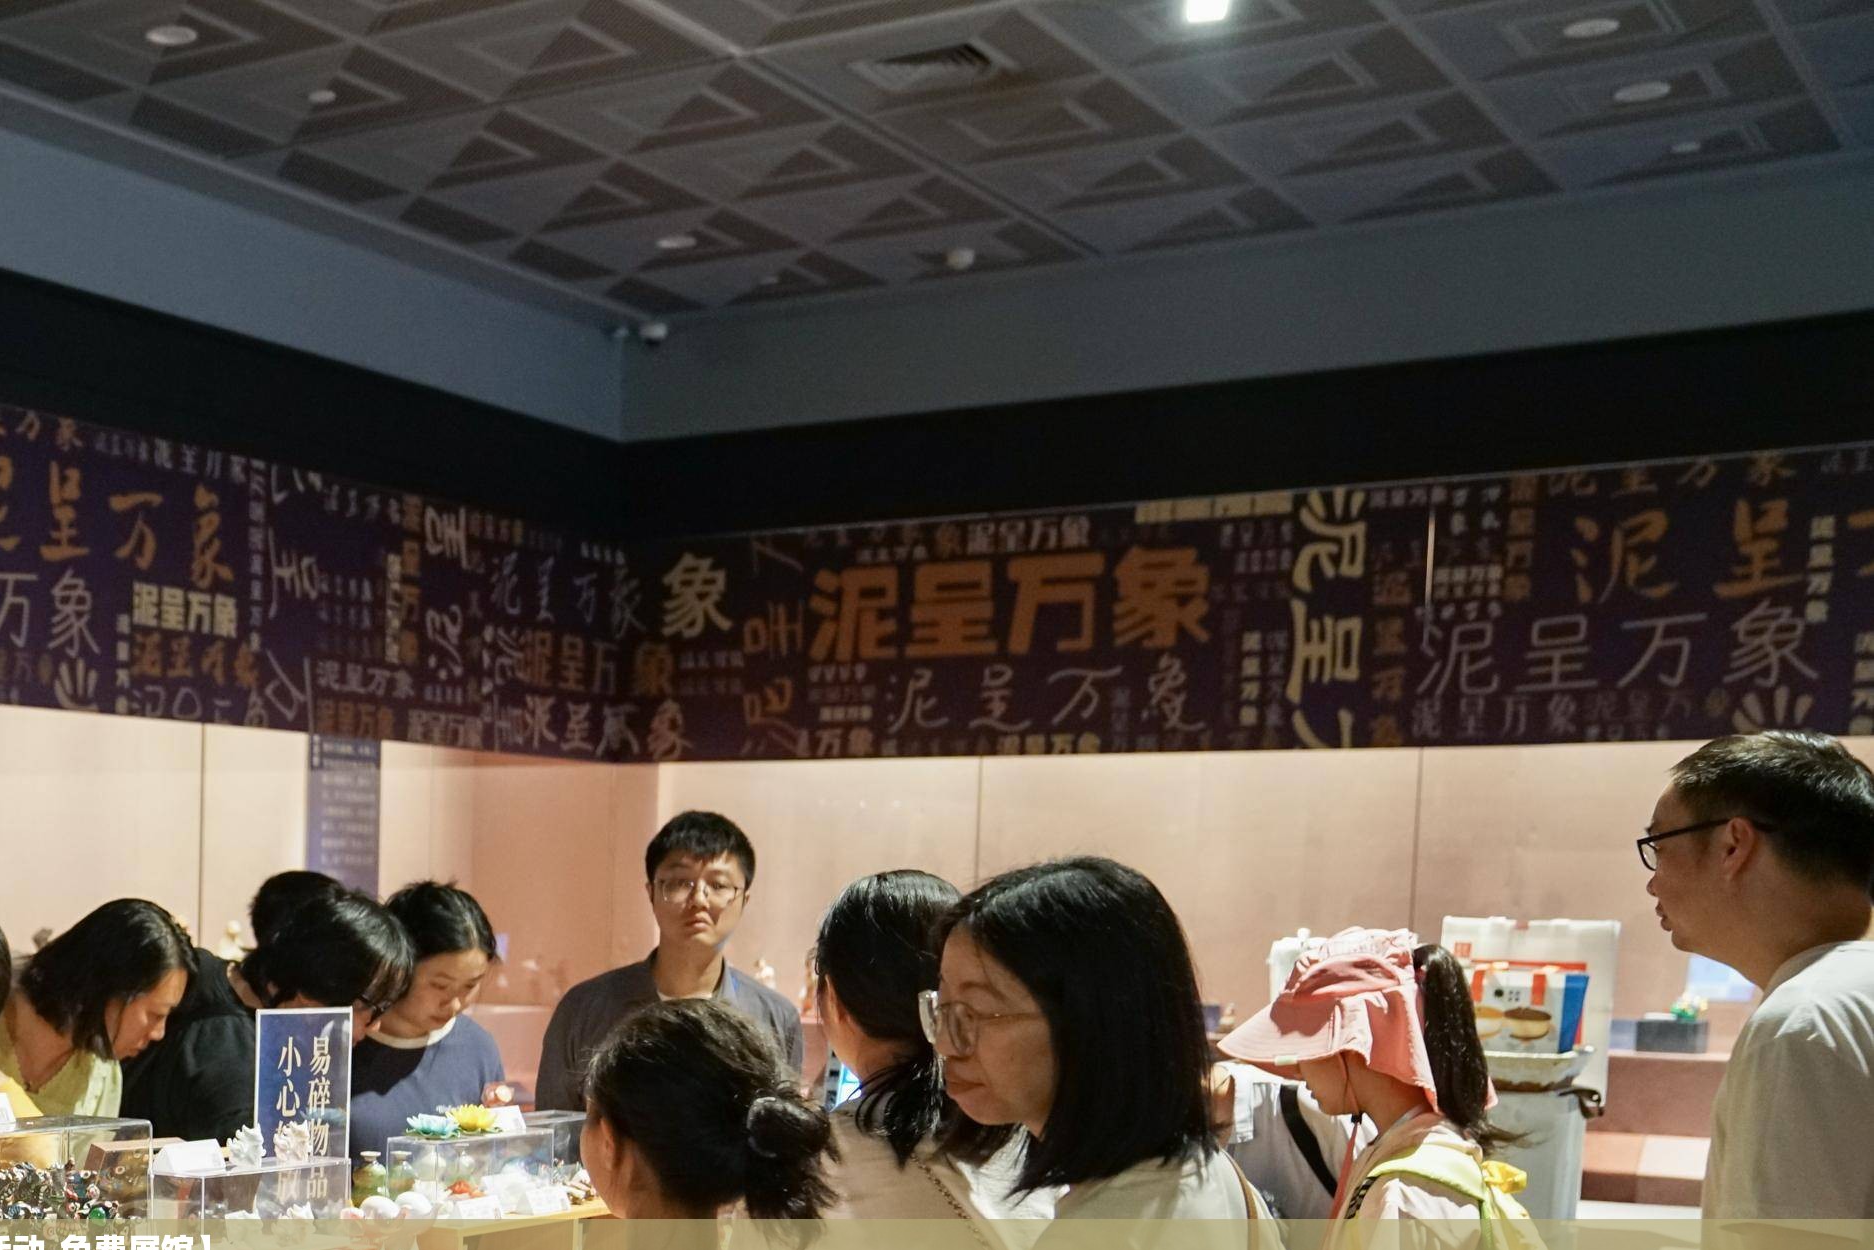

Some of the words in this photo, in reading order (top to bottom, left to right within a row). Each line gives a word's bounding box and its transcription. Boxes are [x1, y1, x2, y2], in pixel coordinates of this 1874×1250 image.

[132, 577, 239, 639] 泥呈万象
[661, 551, 734, 640] 象
[808, 545, 1214, 662] 泥呈万象
[1416, 599, 1820, 696] 泥呈万象
